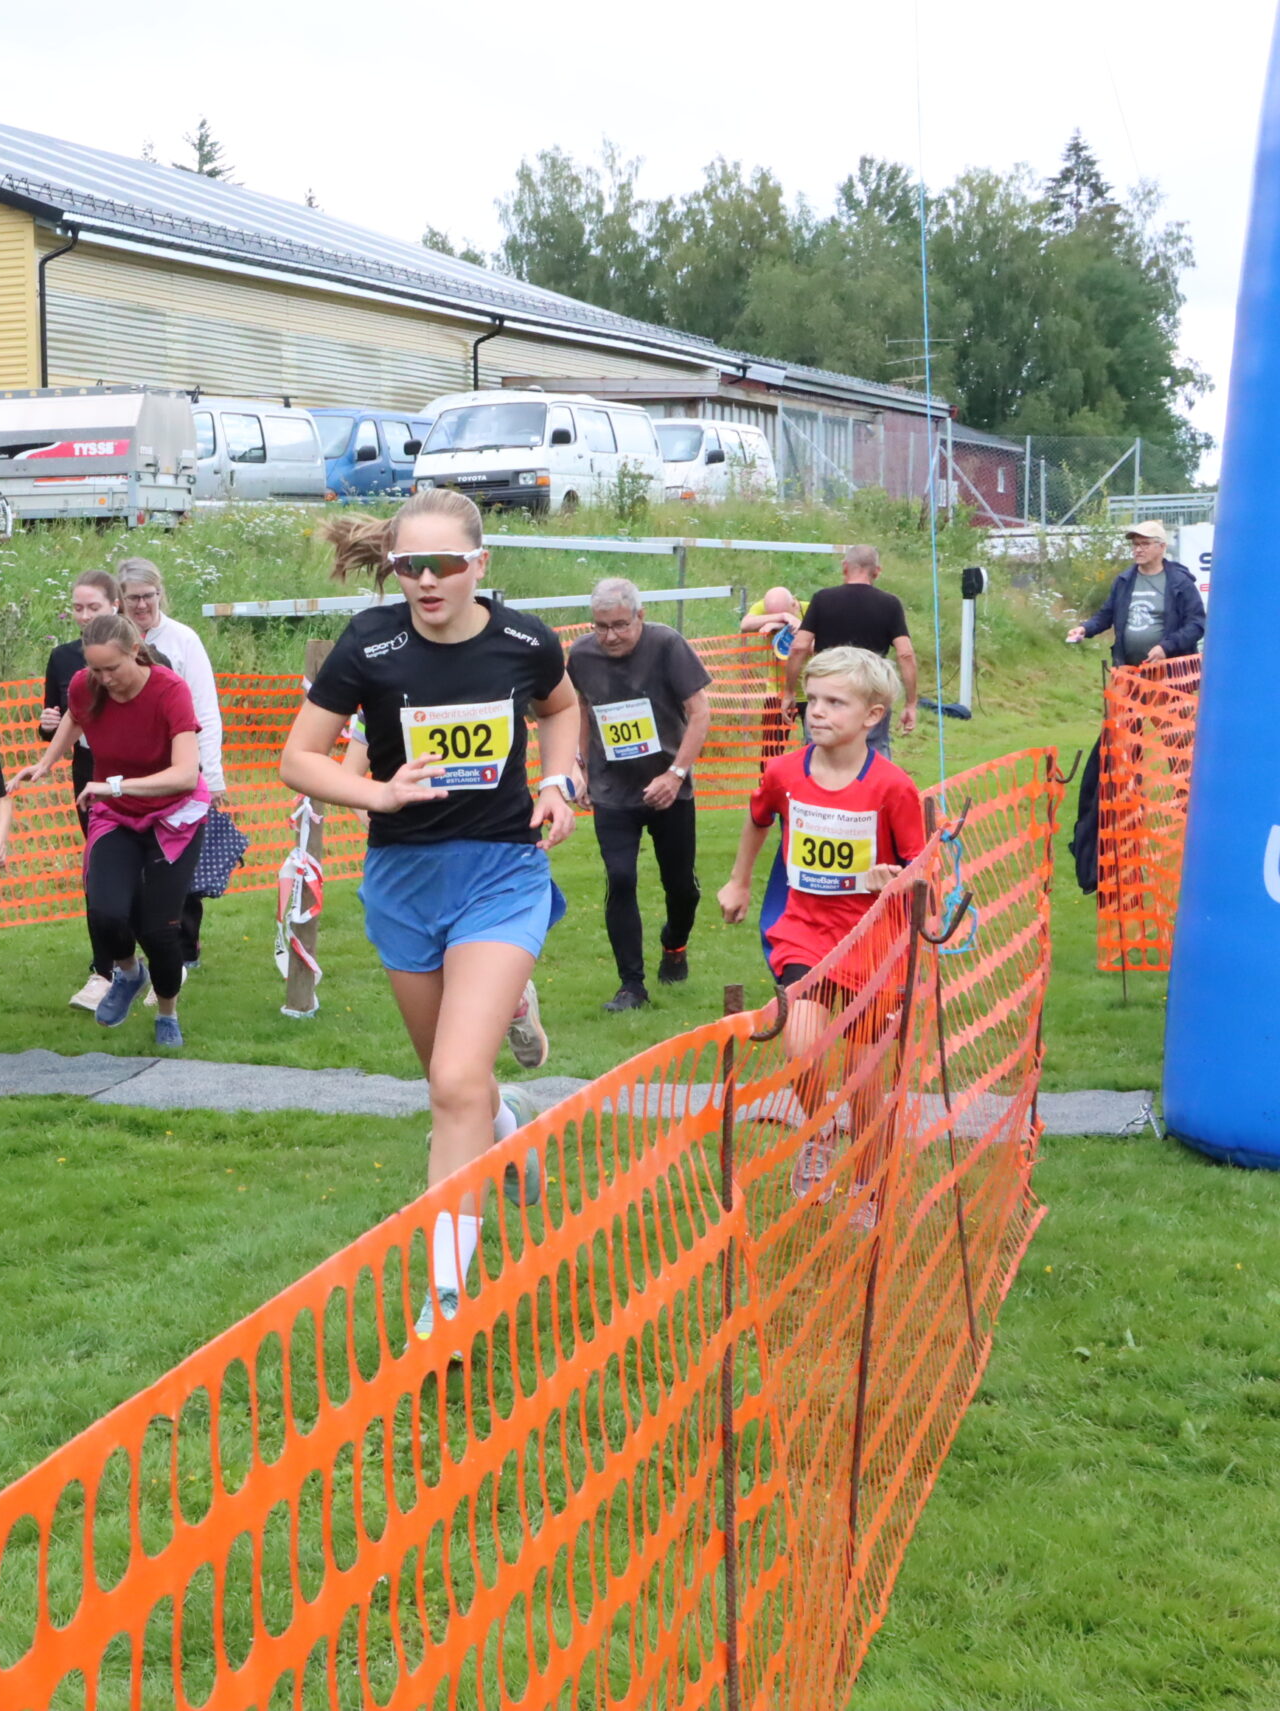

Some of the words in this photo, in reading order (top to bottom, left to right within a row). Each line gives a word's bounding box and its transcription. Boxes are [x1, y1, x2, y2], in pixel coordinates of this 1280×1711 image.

[73, 442, 115, 456] TYSSE
[504, 627, 533, 643] CRAFT
[609, 720, 642, 744] 301
[429, 724, 493, 760] 302
[434, 768, 480, 781] pareBank
[484, 769, 492, 780] 1
[837, 814, 872, 823] Maraton
[801, 837, 854, 869] 309
